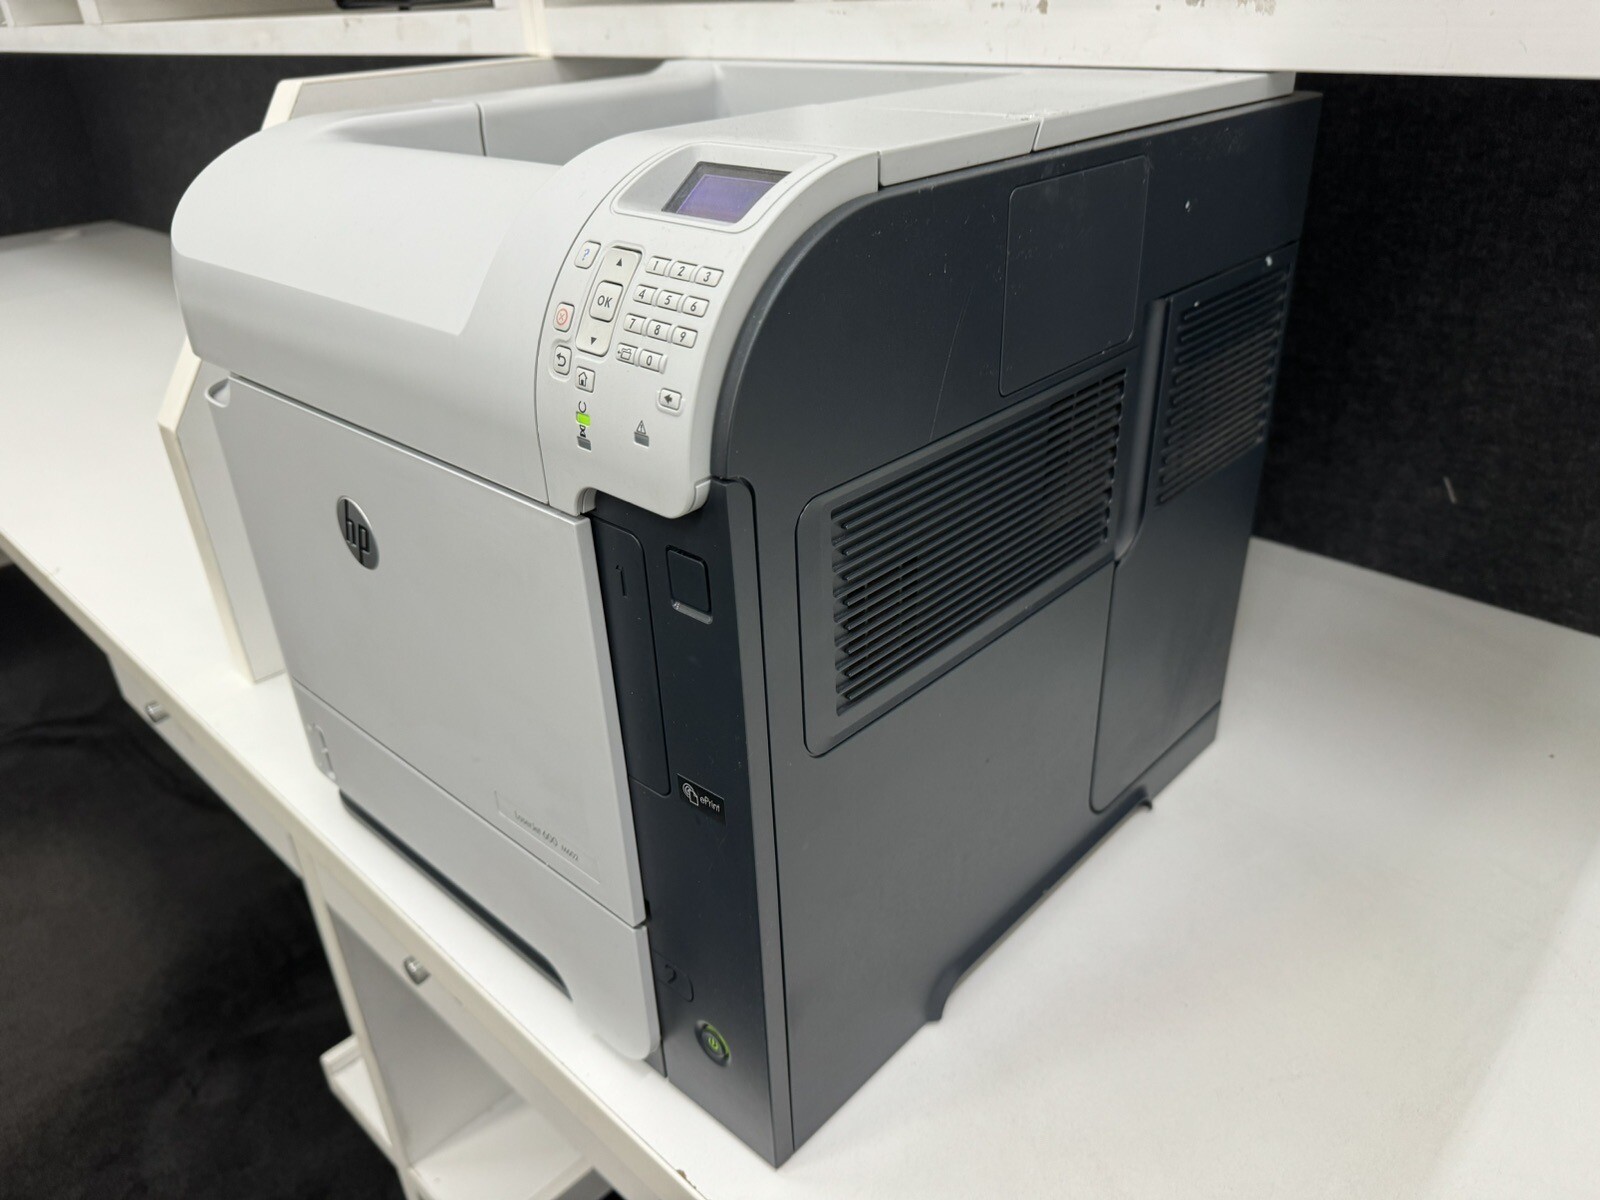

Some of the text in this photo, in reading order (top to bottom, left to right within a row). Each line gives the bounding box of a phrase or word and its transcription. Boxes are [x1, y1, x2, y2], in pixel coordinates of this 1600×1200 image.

[653, 260, 711, 282] 1 2 3
[597, 294, 613, 309] OK
[638, 289, 697, 312] 4 5 6
[628, 318, 687, 342] 7 8 9
[646, 355, 653, 366] 0
[344, 499, 370, 566] hp
[700, 795, 721, 813] ePrint
